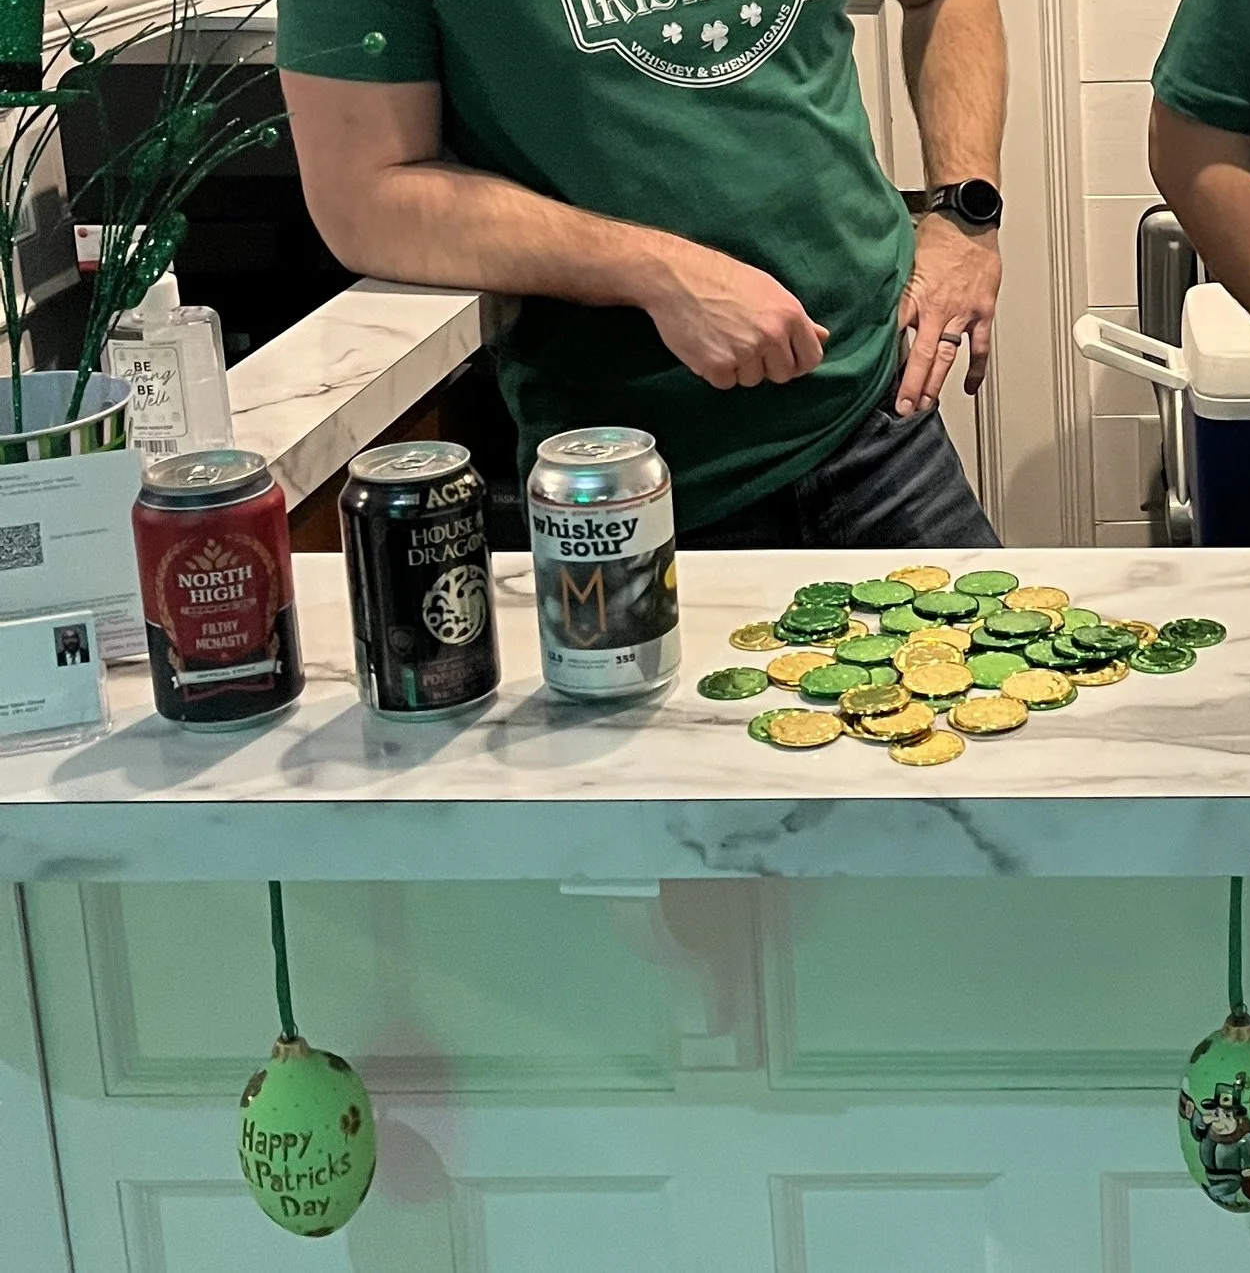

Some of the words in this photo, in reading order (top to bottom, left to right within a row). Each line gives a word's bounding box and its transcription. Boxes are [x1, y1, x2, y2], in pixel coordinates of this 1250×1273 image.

[630, 41, 695, 78] WHISKEY
[696, 66, 709, 78] &
[710, 4, 792, 76] SHENANIGANS
[133, 361, 153, 372] BE
[137, 385, 155, 395] BE
[426, 478, 472, 509] ACE
[411, 516, 474, 546] HOUSE
[533, 515, 639, 542] whiskey
[560, 540, 622, 557] sour
[177, 565, 253, 589] NORTH
[190, 589, 244, 604] HIGH
[202, 621, 240, 636] FILTHY
[195, 632, 249, 651] MCNASTY
[242, 1118, 313, 1161] Happy
[255, 1153, 352, 1193] Patricks
[280, 1195, 331, 1218] Day
